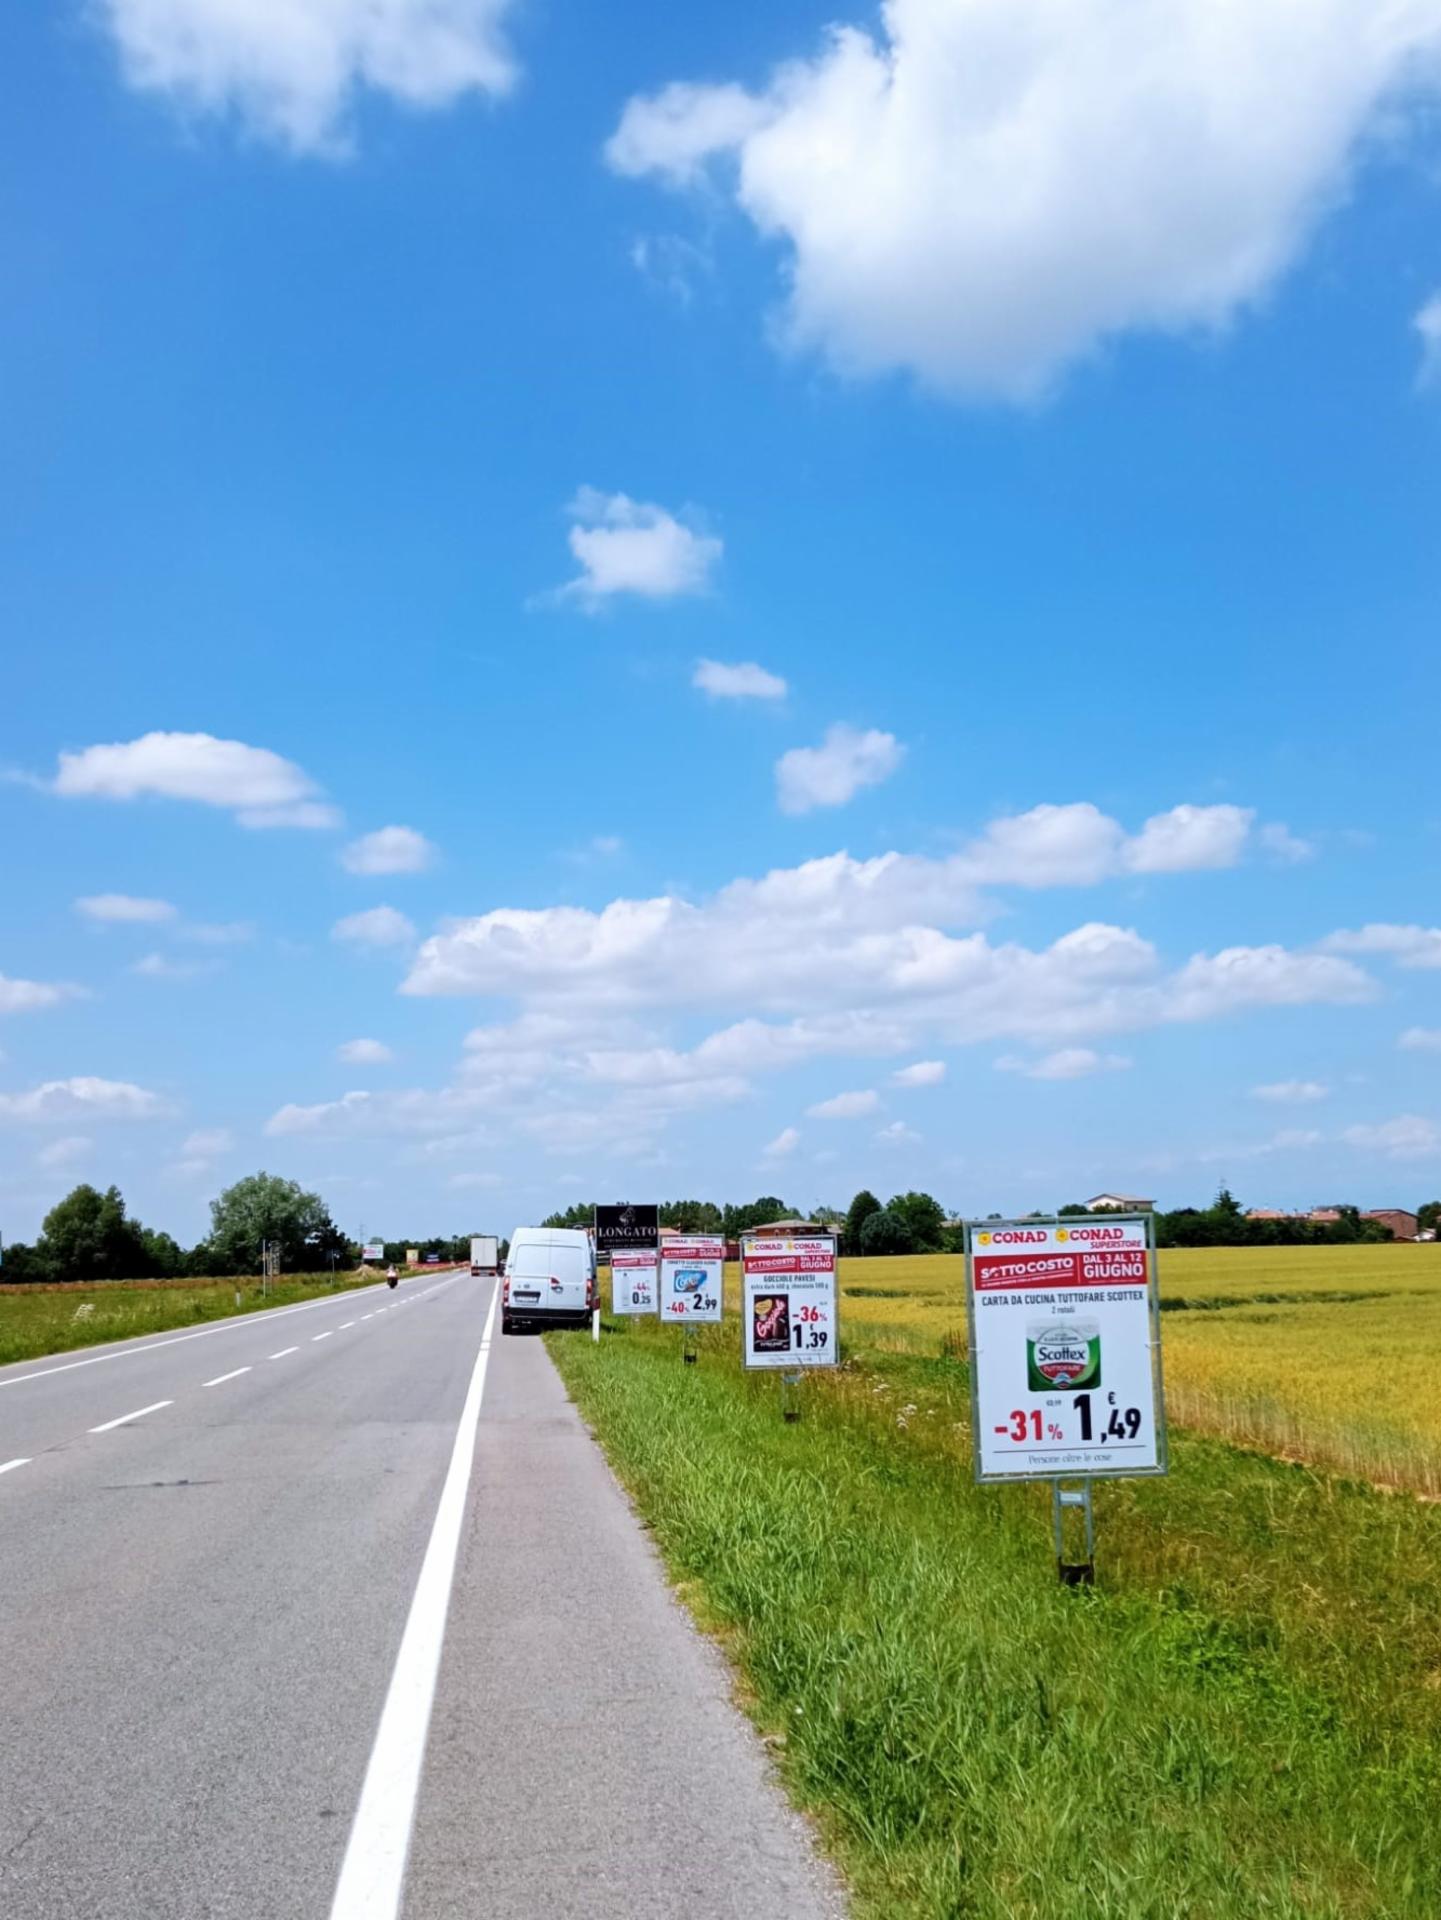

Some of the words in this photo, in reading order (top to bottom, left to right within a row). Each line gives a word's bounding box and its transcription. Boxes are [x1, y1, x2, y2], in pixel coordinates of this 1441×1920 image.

[598, 1226, 656, 1238] LONGATO
[992, 1230, 1048, 1244] CONAD
[1070, 1228, 1124, 1241] CONAD
[1090, 1240, 1142, 1249] SUPERSTORE
[1083, 1254, 1104, 1264] DAL
[1105, 1254, 1112, 1264] 3
[1114, 1253, 1128, 1263] AL
[1130, 1252, 1142, 1262] 12
[800, 1261, 832, 1269] GIUGNO
[1084, 1263, 1144, 1278] GIUGNO
[982, 1296, 1010, 1306] CARTA
[1011, 1294, 1023, 1306] DA
[1025, 1293, 1056, 1305] CUCINA
[1058, 1292, 1106, 1304] TUTTOFARE
[1108, 1290, 1144, 1302] SCOTTEX
[793, 1324, 828, 1350] 1,39
[1038, 1346, 1086, 1362] Scottex
[1073, 1394, 1142, 1444] 1,49
[1028, 1454, 1060, 1464] Persone
